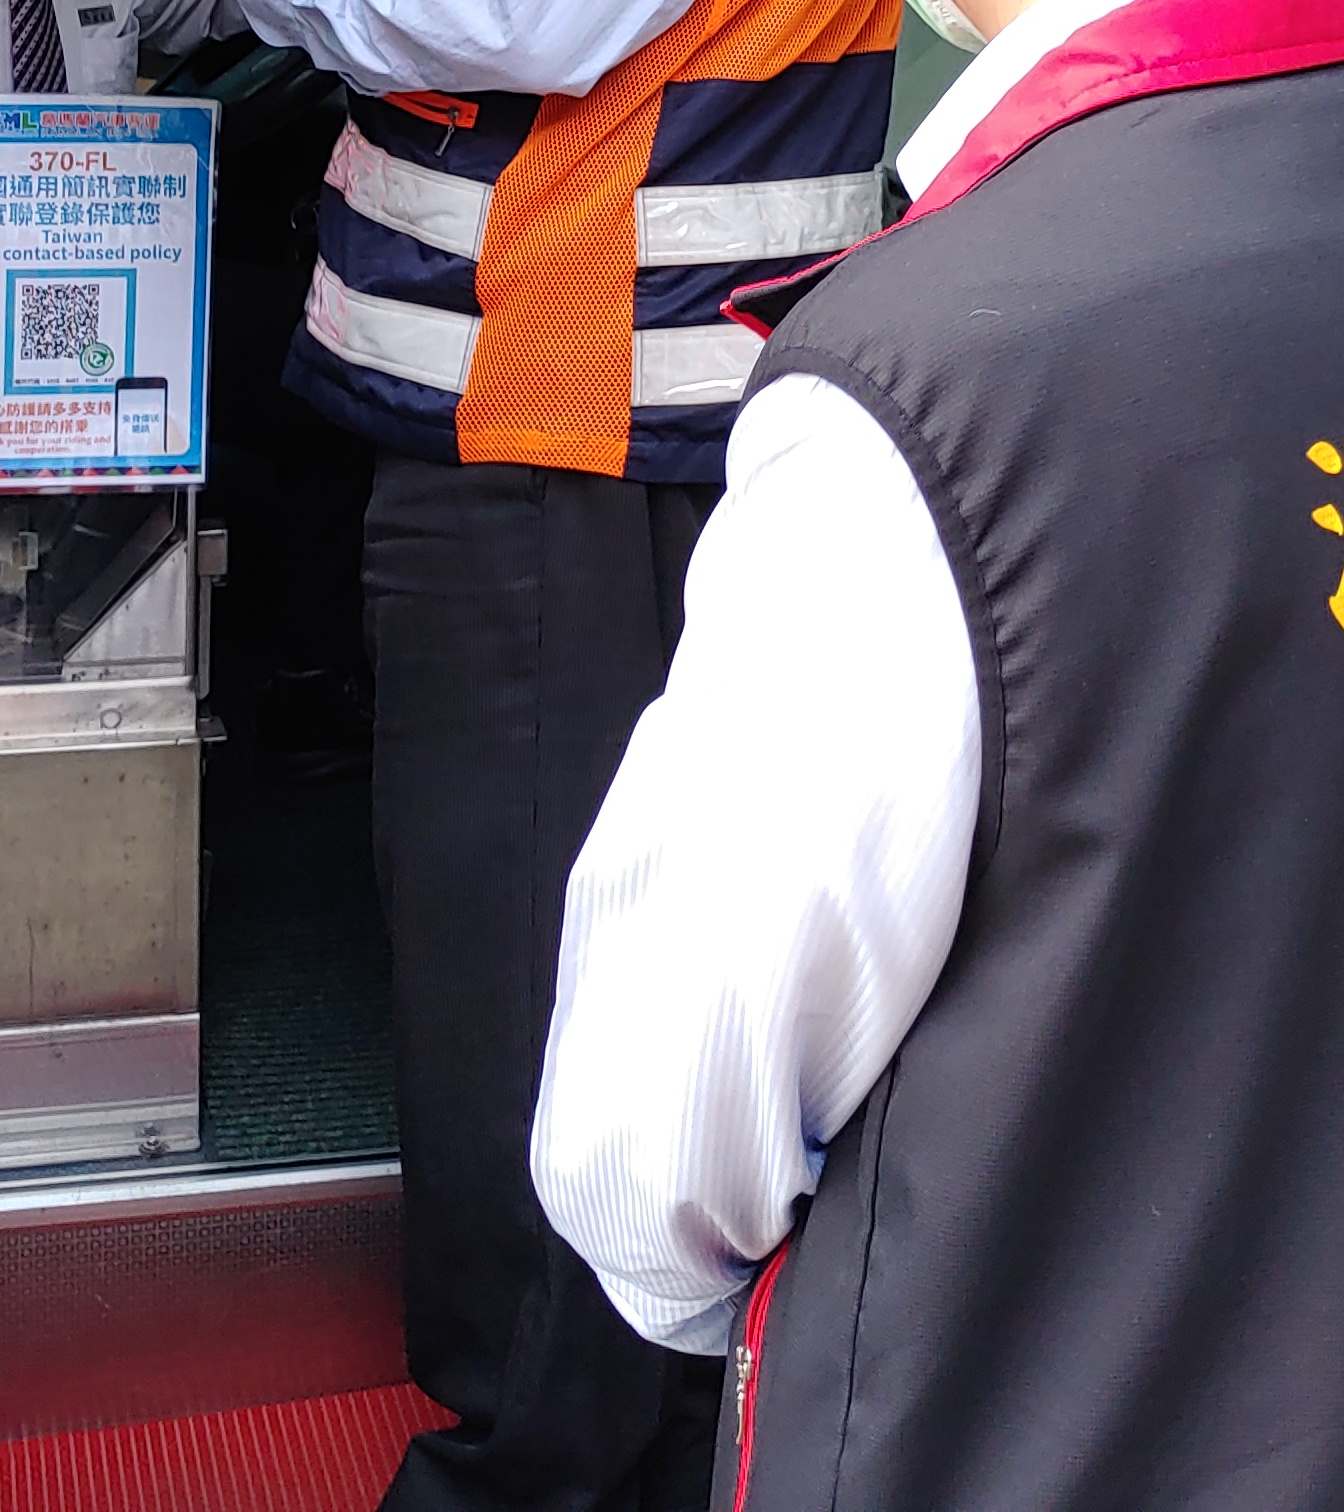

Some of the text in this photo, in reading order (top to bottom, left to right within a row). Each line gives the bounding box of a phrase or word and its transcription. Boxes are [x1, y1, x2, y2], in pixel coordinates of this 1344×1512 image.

[29, 151, 118, 172] 370-FL
[41, 228, 104, 245] Taiwan
[2, 244, 126, 262] contact-based
[130, 244, 183, 264] policy
